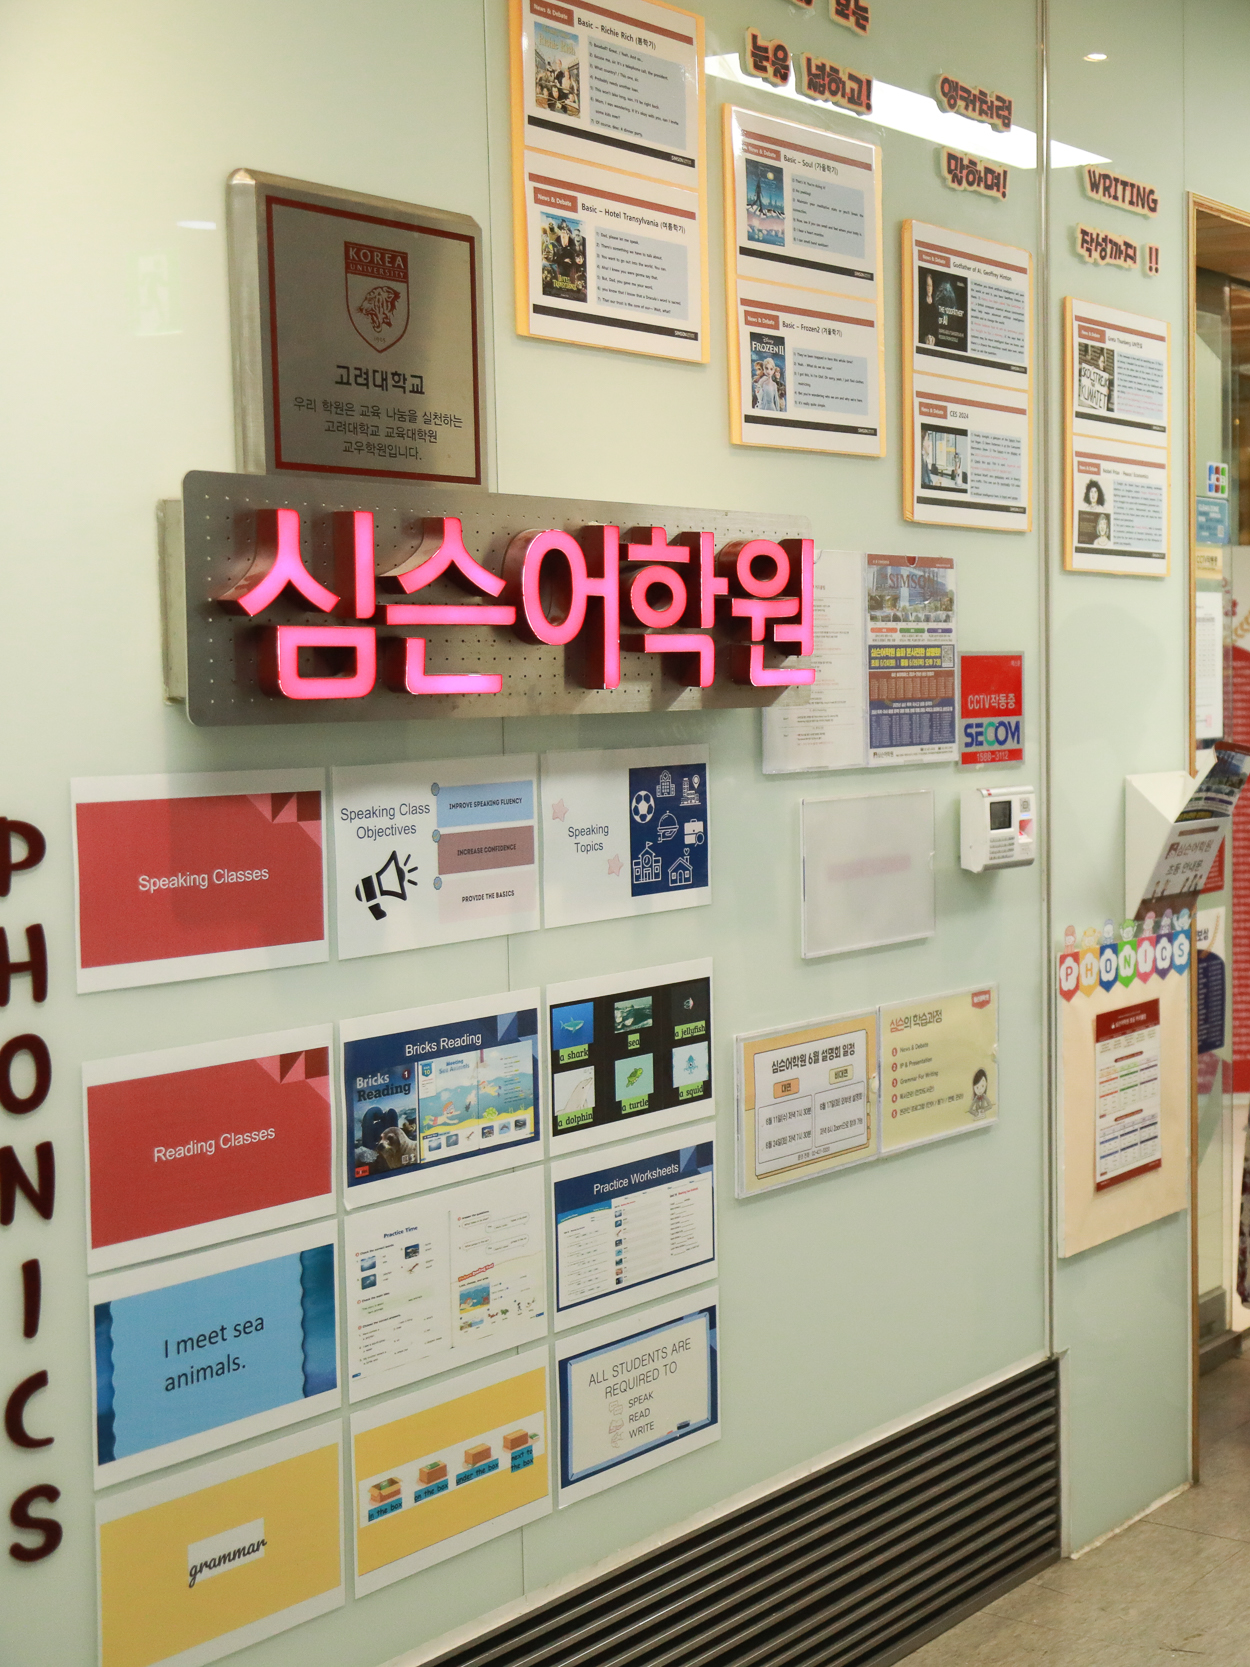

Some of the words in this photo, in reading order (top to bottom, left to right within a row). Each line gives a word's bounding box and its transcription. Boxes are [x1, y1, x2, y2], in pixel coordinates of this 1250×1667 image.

[534, 4, 546, 12] News
[552, 10, 568, 20] Debate
[577, 18, 593, 29] Basic
[601, 25, 619, 37] Richie
[621, 32, 634, 42] Rich
[751, 32, 789, 82] 눈을
[806, 55, 873, 113] 넓히고!
[939, 77, 1013, 129] 앵커처럼
[784, 154, 797, 164] Basic
[802, 160, 814, 169] Soul
[946, 150, 1007, 199] 말하며!
[1087, 168, 1158, 215] WRITING
[538, 194, 550, 202] News
[556, 198, 572, 207] Debate
[581, 203, 597, 213] Basic
[605, 209, 622, 219] Hotel
[623, 212, 659, 227] Transylvania
[1080, 228, 1138, 265] 작성까지
[350, 248, 404, 268] KOREA
[351, 264, 405, 279] UNIVERSITY
[953, 262, 971, 272] Godfather
[983, 269, 999, 279] Geoffrey
[999, 273, 1012, 281] Hinton
[782, 321, 795, 330] Basic
[801, 323, 820, 333] Frozen2
[752, 341, 778, 354] FROZEN
[778, 345, 784, 355] II
[334, 364, 425, 395] 고려대학교
[294, 397, 316, 412] 우리
[322, 400, 355, 416] 학원은
[360, 405, 381, 419] 교육
[387, 407, 417, 422] 나눔을
[422, 412, 463, 428] 실천하는
[959, 411, 969, 419] 2024
[325, 421, 379, 437] 고려대학교
[385, 426, 437, 443] 교육대학원
[343, 441, 421, 460] 교우학원입니다.
[1208, 474, 1226, 485] JCB
[888, 573, 936, 590] SIMSON
[226, 508, 816, 699] 심슨어학원
[967, 694, 1016, 710] CCTV작동중
[964, 720, 1020, 748] SECOM
[976, 751, 1008, 762] 1588-3112
[341, 806, 395, 823] Speaking
[400, 803, 430, 815] Class
[449, 801, 472, 810] IMPROVE
[474, 799, 499, 808] SPEAKING
[357, 824, 417, 841] Objectives
[568, 824, 609, 839] Speaking
[457, 847, 483, 856] INCREASE
[484, 844, 516, 854] CONFIDENCE
[575, 841, 603, 854] Topics
[1177, 840, 1213, 856] 심슨어학원
[1166, 863, 1181, 875] 초등
[1182, 860, 1203, 874] 안내문
[139, 872, 208, 893] Speaking
[213, 868, 268, 884] Classes
[462, 894, 484, 902] PROVIDE
[496, 890, 514, 898] BASICS
[1066, 942, 1184, 982] PHONICS
[890, 1016, 911, 1033] 심슨의
[913, 1010, 943, 1026] 학습과정
[681, 1025, 705, 1038] jellyfish
[406, 1041, 437, 1056] Bricks
[440, 1033, 482, 1050] Reading
[568, 1048, 588, 1059] shark
[772, 1056, 806, 1073] 심슨어학원
[809, 1052, 819, 1064] 6월
[821, 1047, 840, 1062] 설명회
[843, 1042, 855, 1056] 일정
[356, 1073, 389, 1088] Bricks
[834, 1068, 848, 1079] 비대면
[357, 1083, 411, 1102] Reading
[686, 1085, 703, 1097] squid
[781, 1083, 791, 1092] 대면
[629, 1099, 648, 1110] turtle
[566, 1112, 593, 1125] dolphin
[155, 1137, 215, 1162] Reading
[220, 1128, 275, 1148] Classes
[594, 1177, 628, 1195] Practice
[631, 1164, 679, 1185] Worksheets
[0, 817, 63, 1563] PHONICS
[384, 1228, 403, 1238] Practice
[405, 1225, 417, 1234] Time
[164, 1340, 168, 1359] I
[176, 1325, 227, 1356] meet
[233, 1316, 265, 1338] sea
[589, 1370, 608, 1387] ALL
[612, 1346, 668, 1378] STUDENTS
[671, 1338, 691, 1355] ARE
[165, 1354, 246, 1392] animals.
[605, 1368, 659, 1399] REQUIRED
[664, 1361, 677, 1375] TO
[628, 1391, 654, 1408] SPEAK
[629, 1408, 650, 1423] READ
[629, 1421, 654, 1438] WRITE
[511, 1452, 524, 1462] next
[526, 1448, 533, 1456] to
[511, 1461, 520, 1471] the
[522, 1457, 533, 1468] box
[456, 1472, 473, 1484] under
[476, 1468, 486, 1477] the
[488, 1462, 498, 1472] box
[424, 1490, 435, 1499] the
[437, 1483, 448, 1493] box
[369, 1512, 375, 1520] in
[377, 1507, 388, 1517] the
[390, 1501, 402, 1512] box
[189, 1537, 267, 1588] grammar
